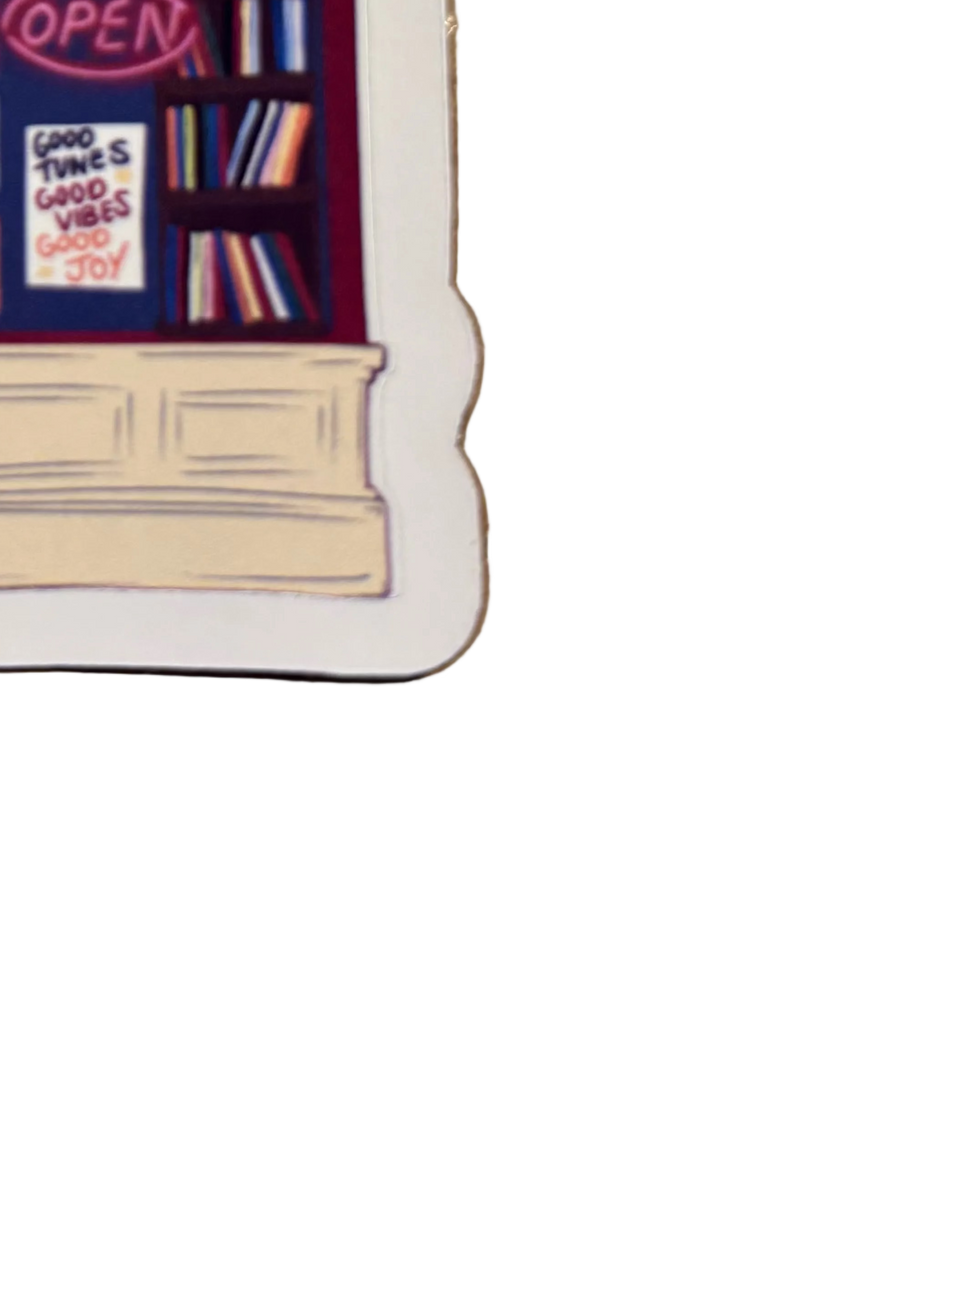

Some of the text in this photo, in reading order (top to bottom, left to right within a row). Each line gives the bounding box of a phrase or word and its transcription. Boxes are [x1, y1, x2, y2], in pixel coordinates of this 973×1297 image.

[33, 126, 95, 158] GOOD
[33, 139, 130, 182] TUNES
[35, 177, 107, 210] GOOD
[54, 188, 131, 231] VIBES
[35, 227, 111, 258] GOOD
[65, 240, 131, 282] JOY
